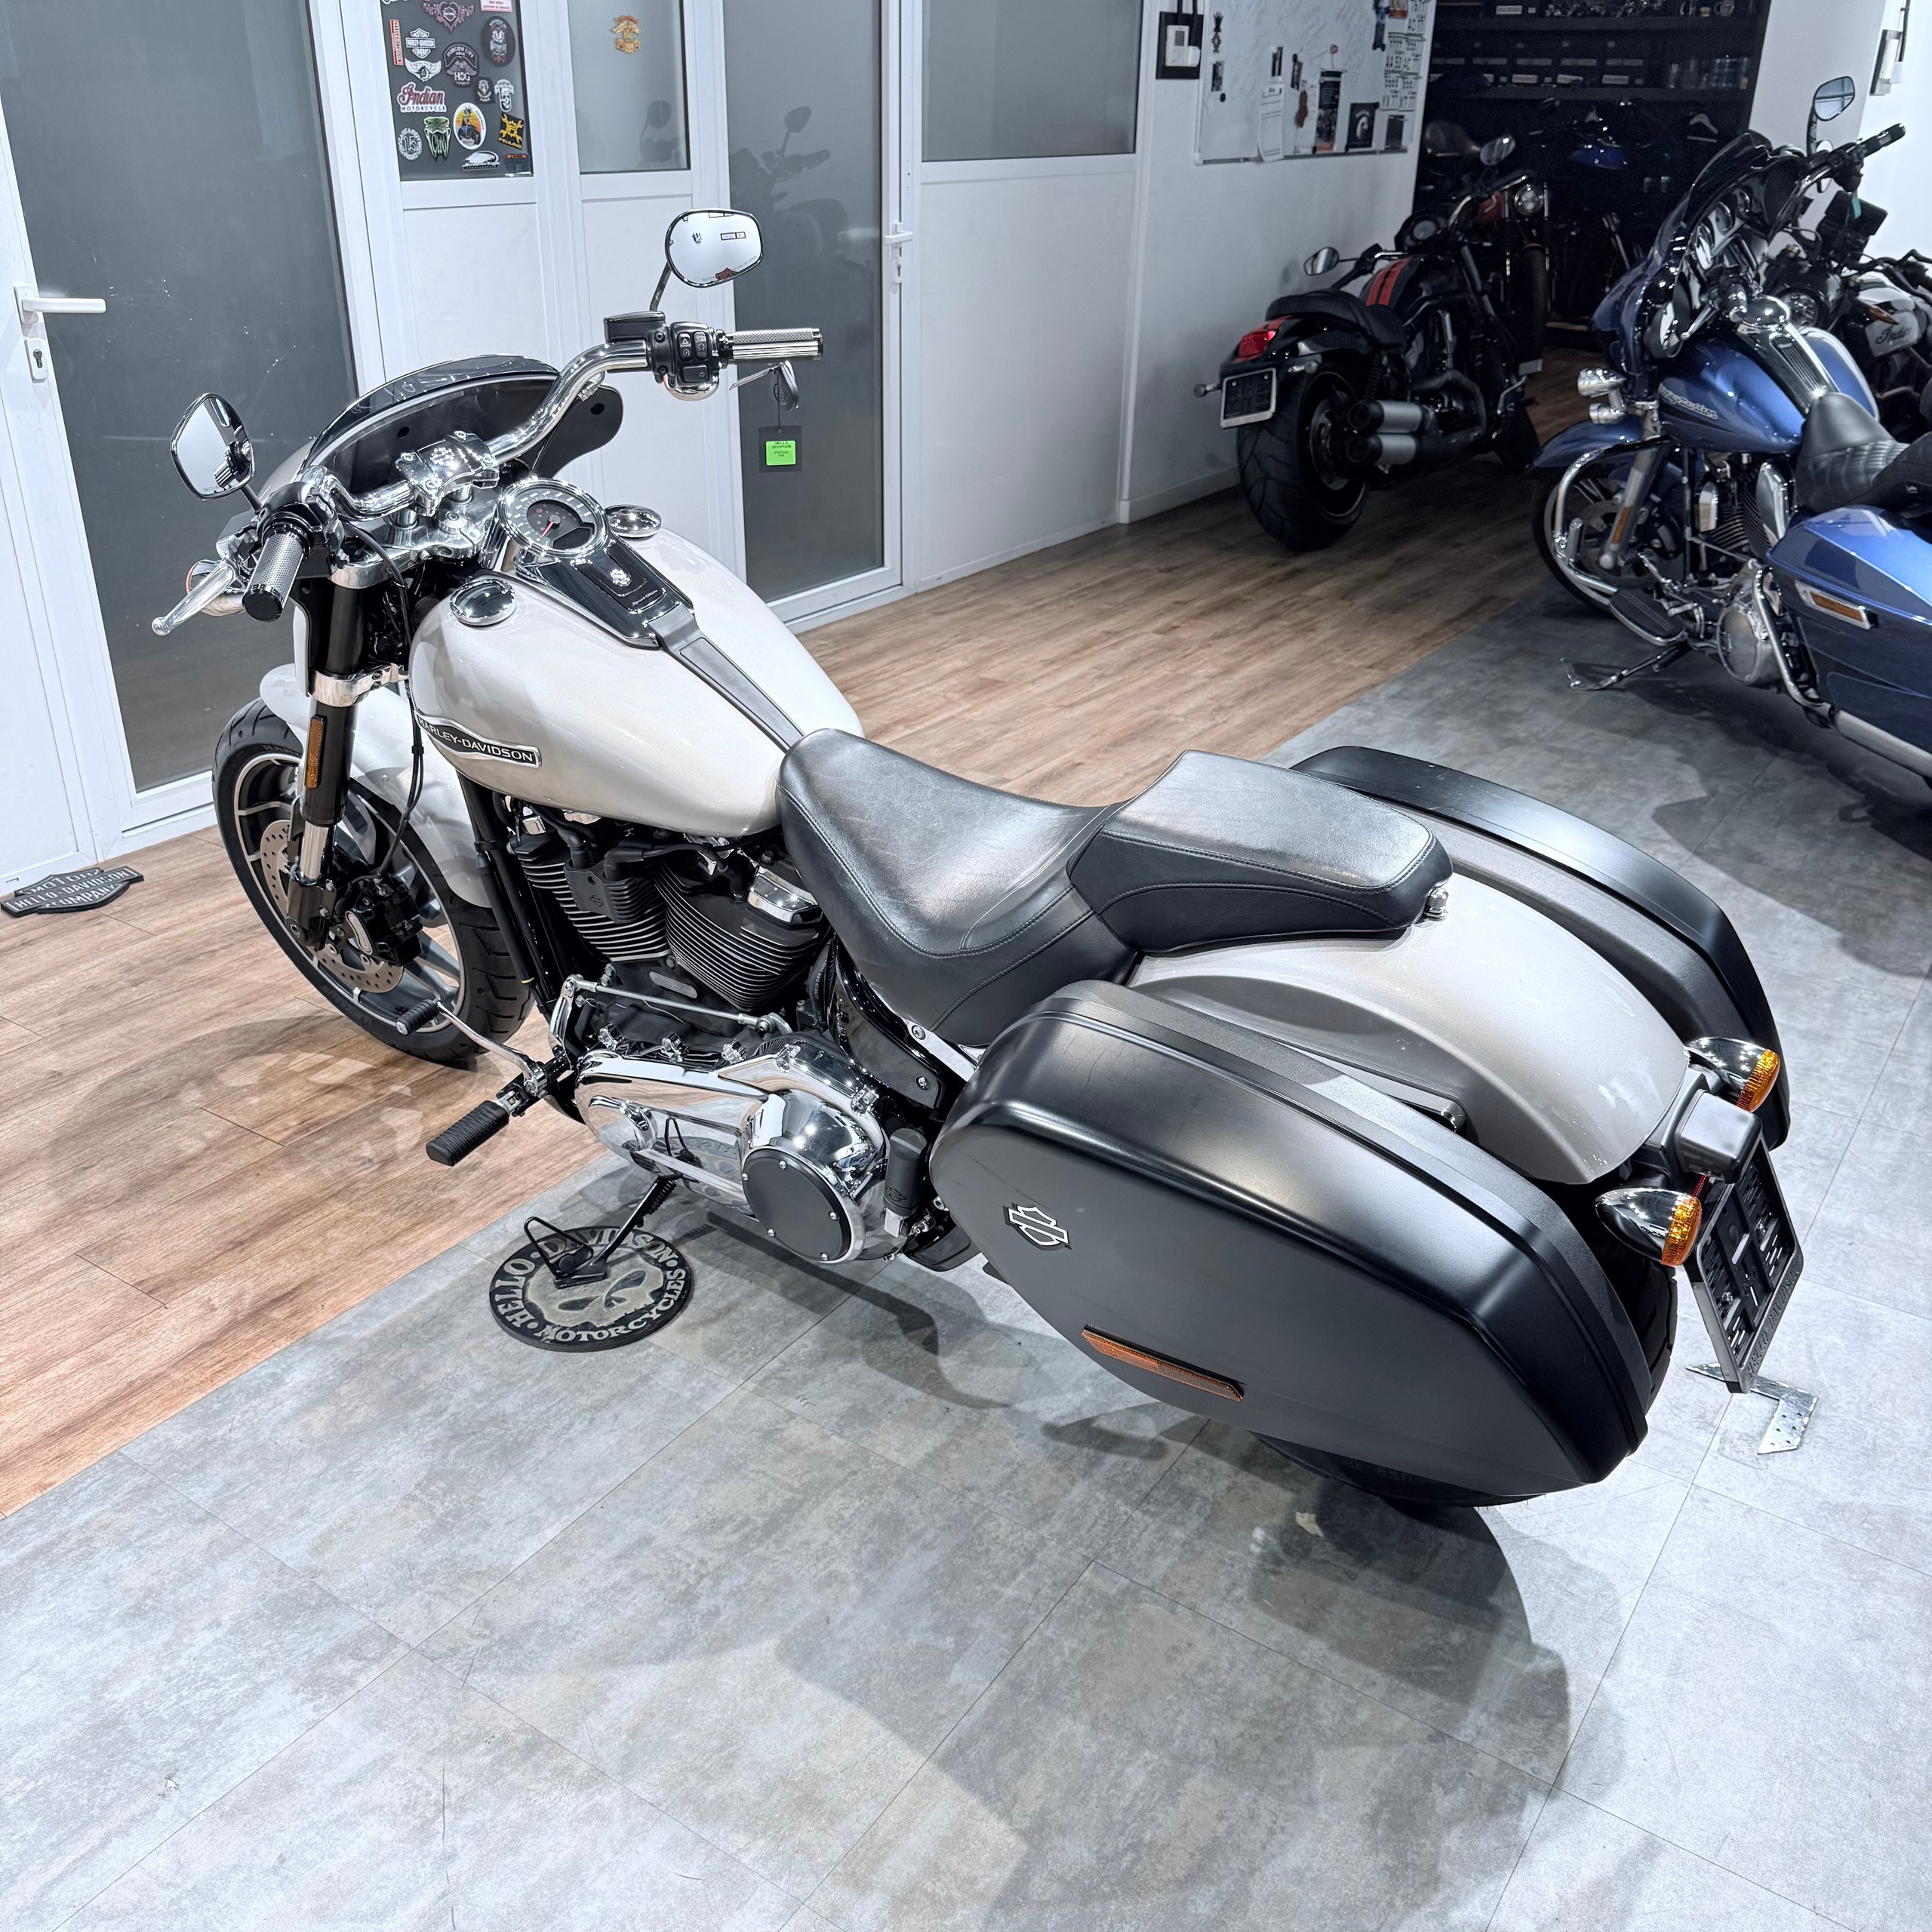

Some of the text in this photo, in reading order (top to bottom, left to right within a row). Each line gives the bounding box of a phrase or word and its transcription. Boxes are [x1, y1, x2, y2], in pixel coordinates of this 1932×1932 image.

[398, 82, 445, 106] Indian
[418, 717, 533, 762] HARLEY-DAVIDSON
[494, 1258, 536, 1327] HELLO
[534, 1268, 687, 1344] MOTORCYCLES
